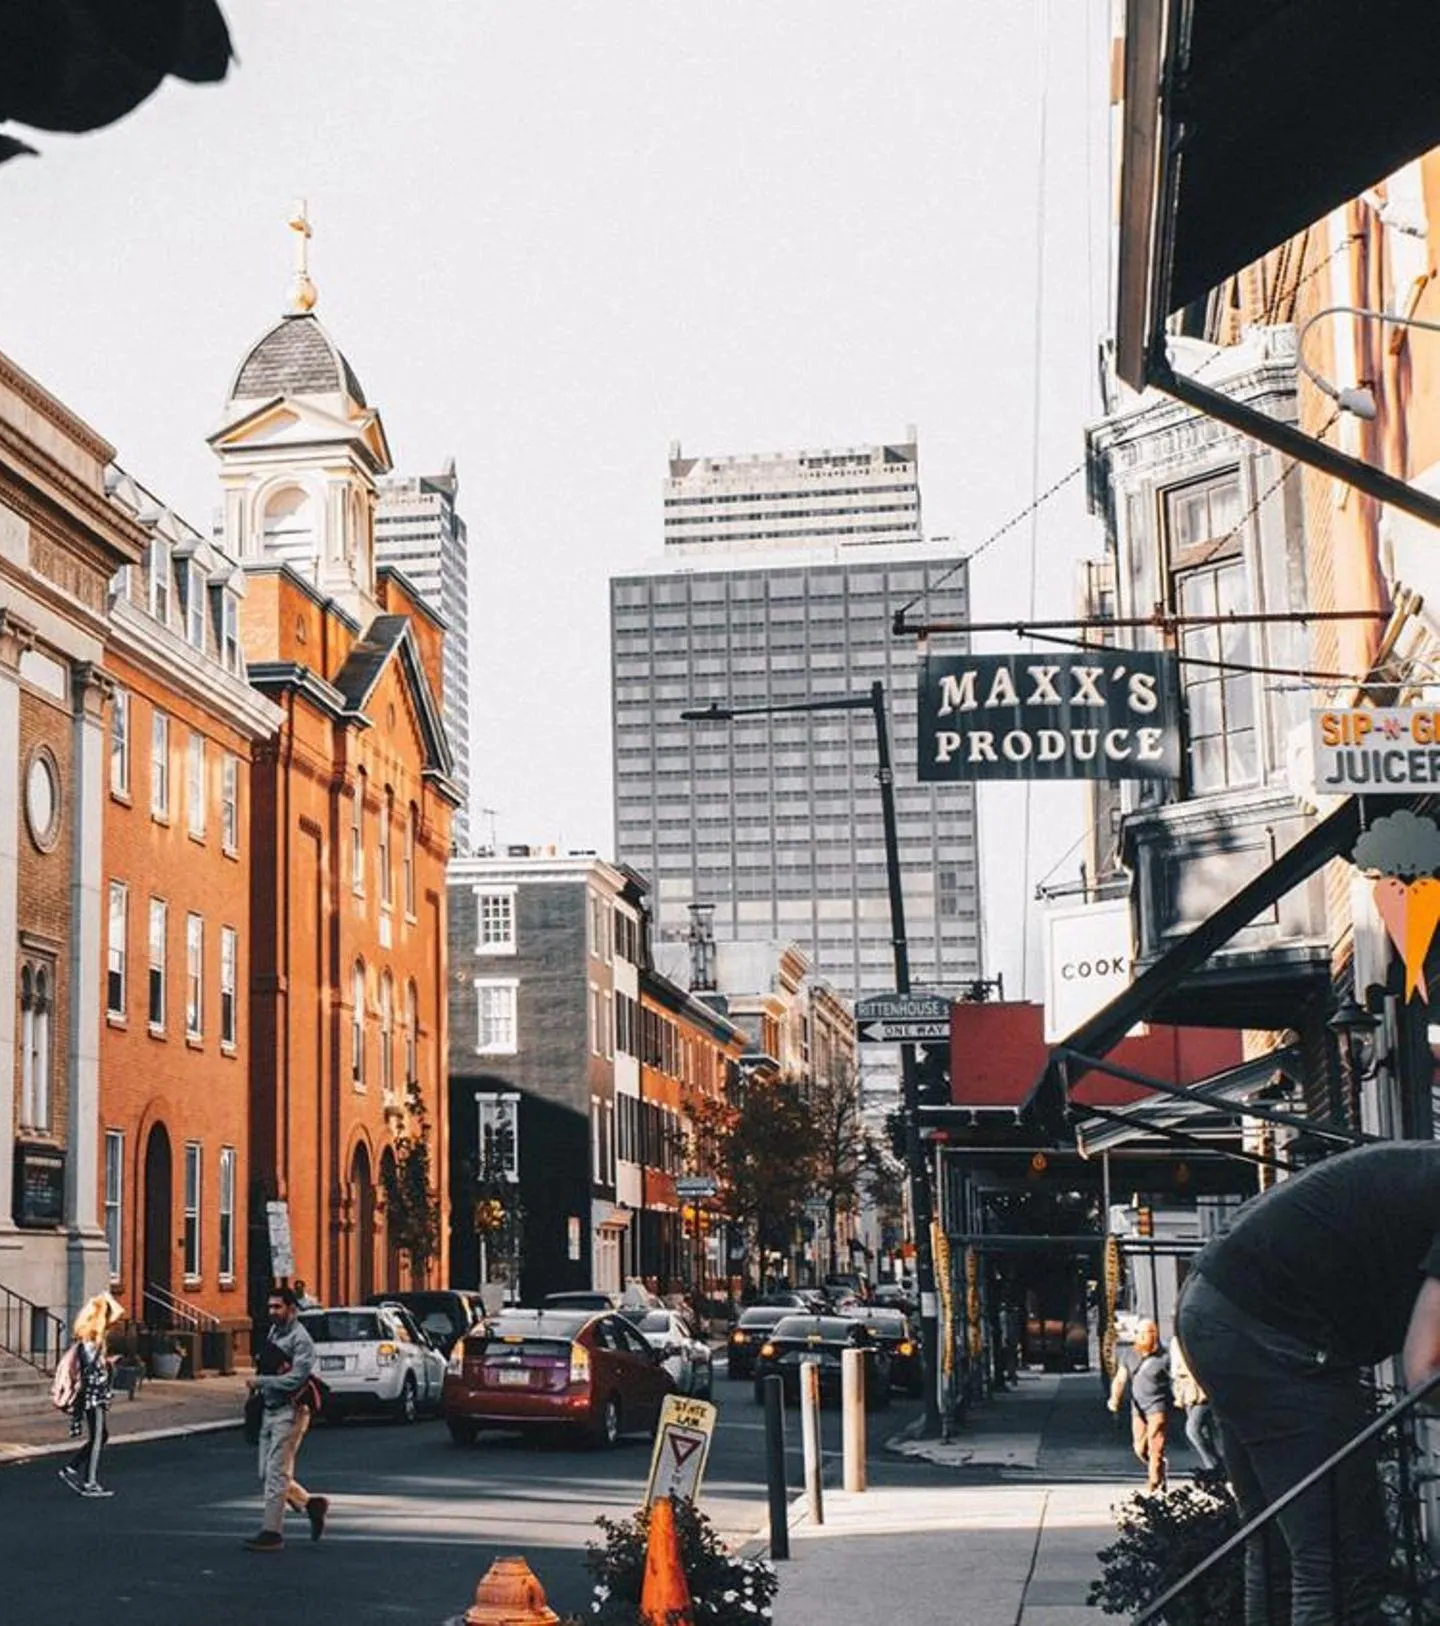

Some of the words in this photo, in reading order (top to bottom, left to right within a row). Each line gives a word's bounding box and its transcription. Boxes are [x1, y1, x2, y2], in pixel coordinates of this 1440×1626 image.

[937, 665, 1158, 717] MAXX'S
[935, 727, 1163, 763] PRODUCE
[1061, 957, 1125, 980] COOK
[885, 1026, 909, 1036] ONE
[916, 1025, 944, 1035] WAY
